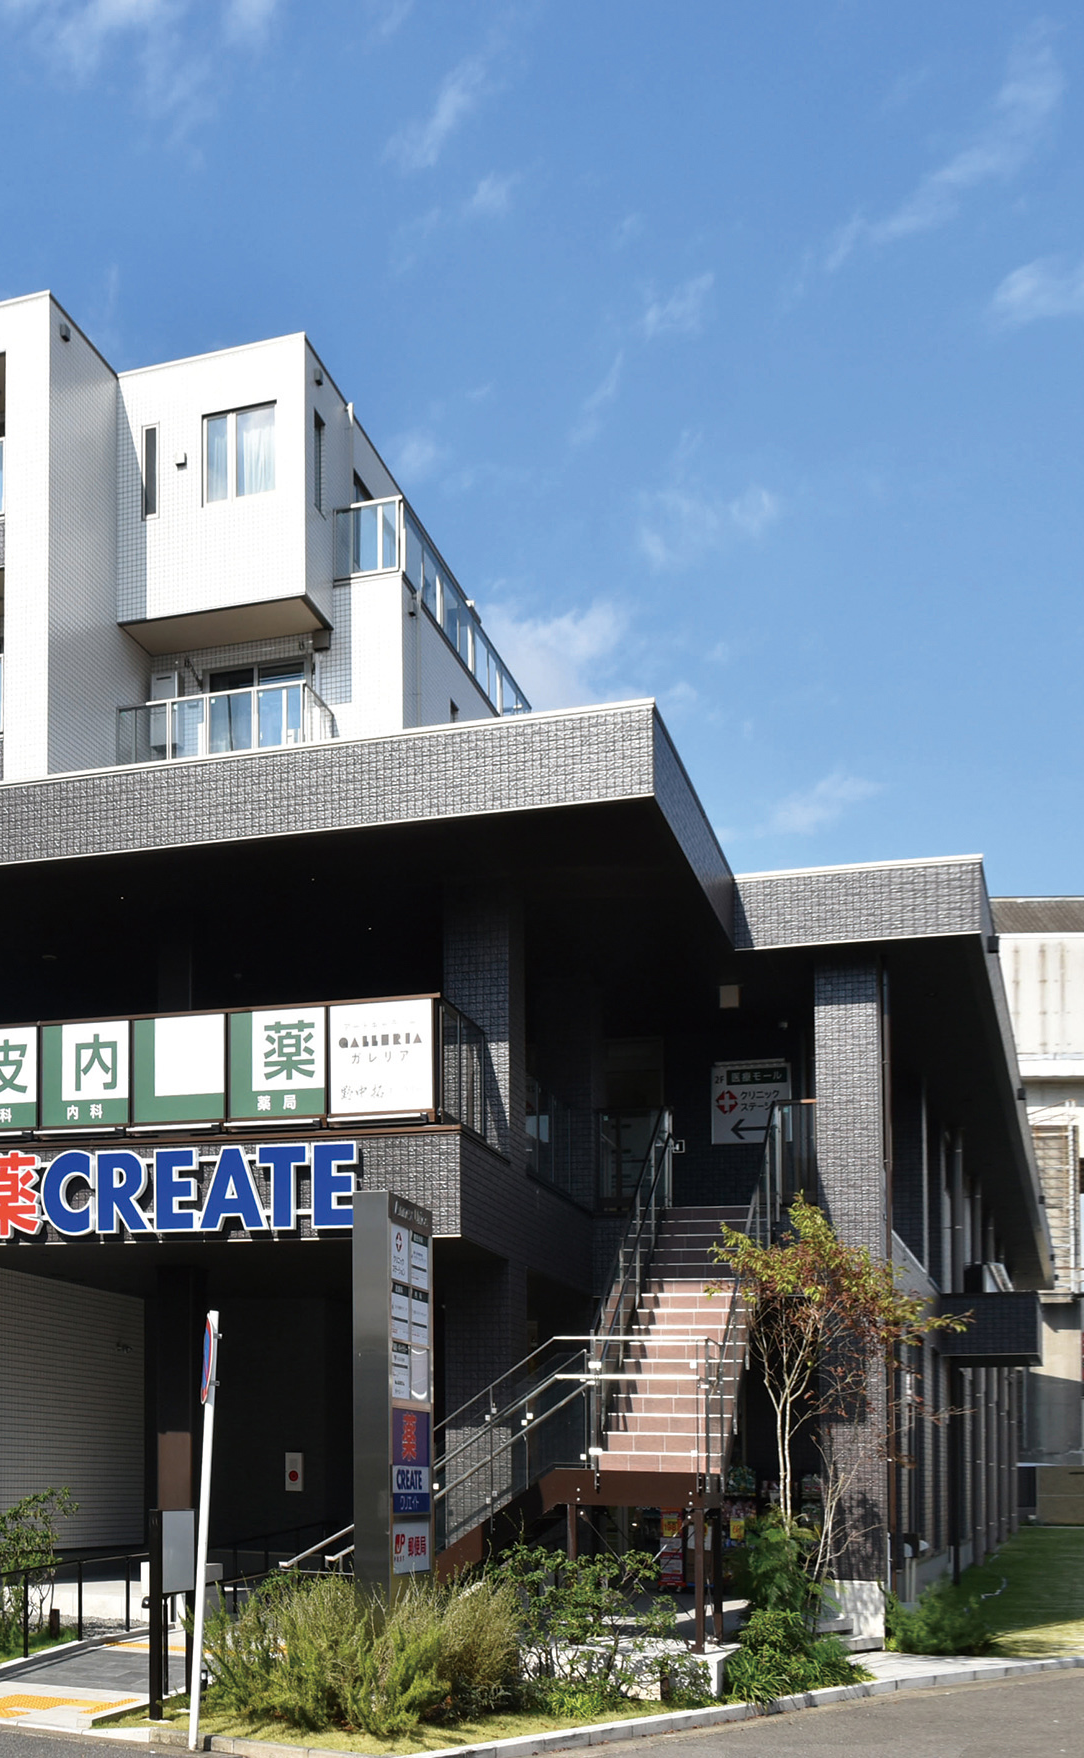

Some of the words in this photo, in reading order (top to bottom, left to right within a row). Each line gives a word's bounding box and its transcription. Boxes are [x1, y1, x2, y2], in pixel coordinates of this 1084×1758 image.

[263, 1019, 315, 1080] 薬
[351, 1050, 409, 1065] ガレリア
[75, 1033, 118, 1092] 内
[257, 1094, 297, 1111] 薬局
[740, 1089, 780, 1100] クリニック
[66, 1103, 103, 1120] 内科
[402, 1412, 417, 1461] 薬
[396, 1469, 423, 1490] CREATE
[408, 1535, 427, 1558] 郵便局
